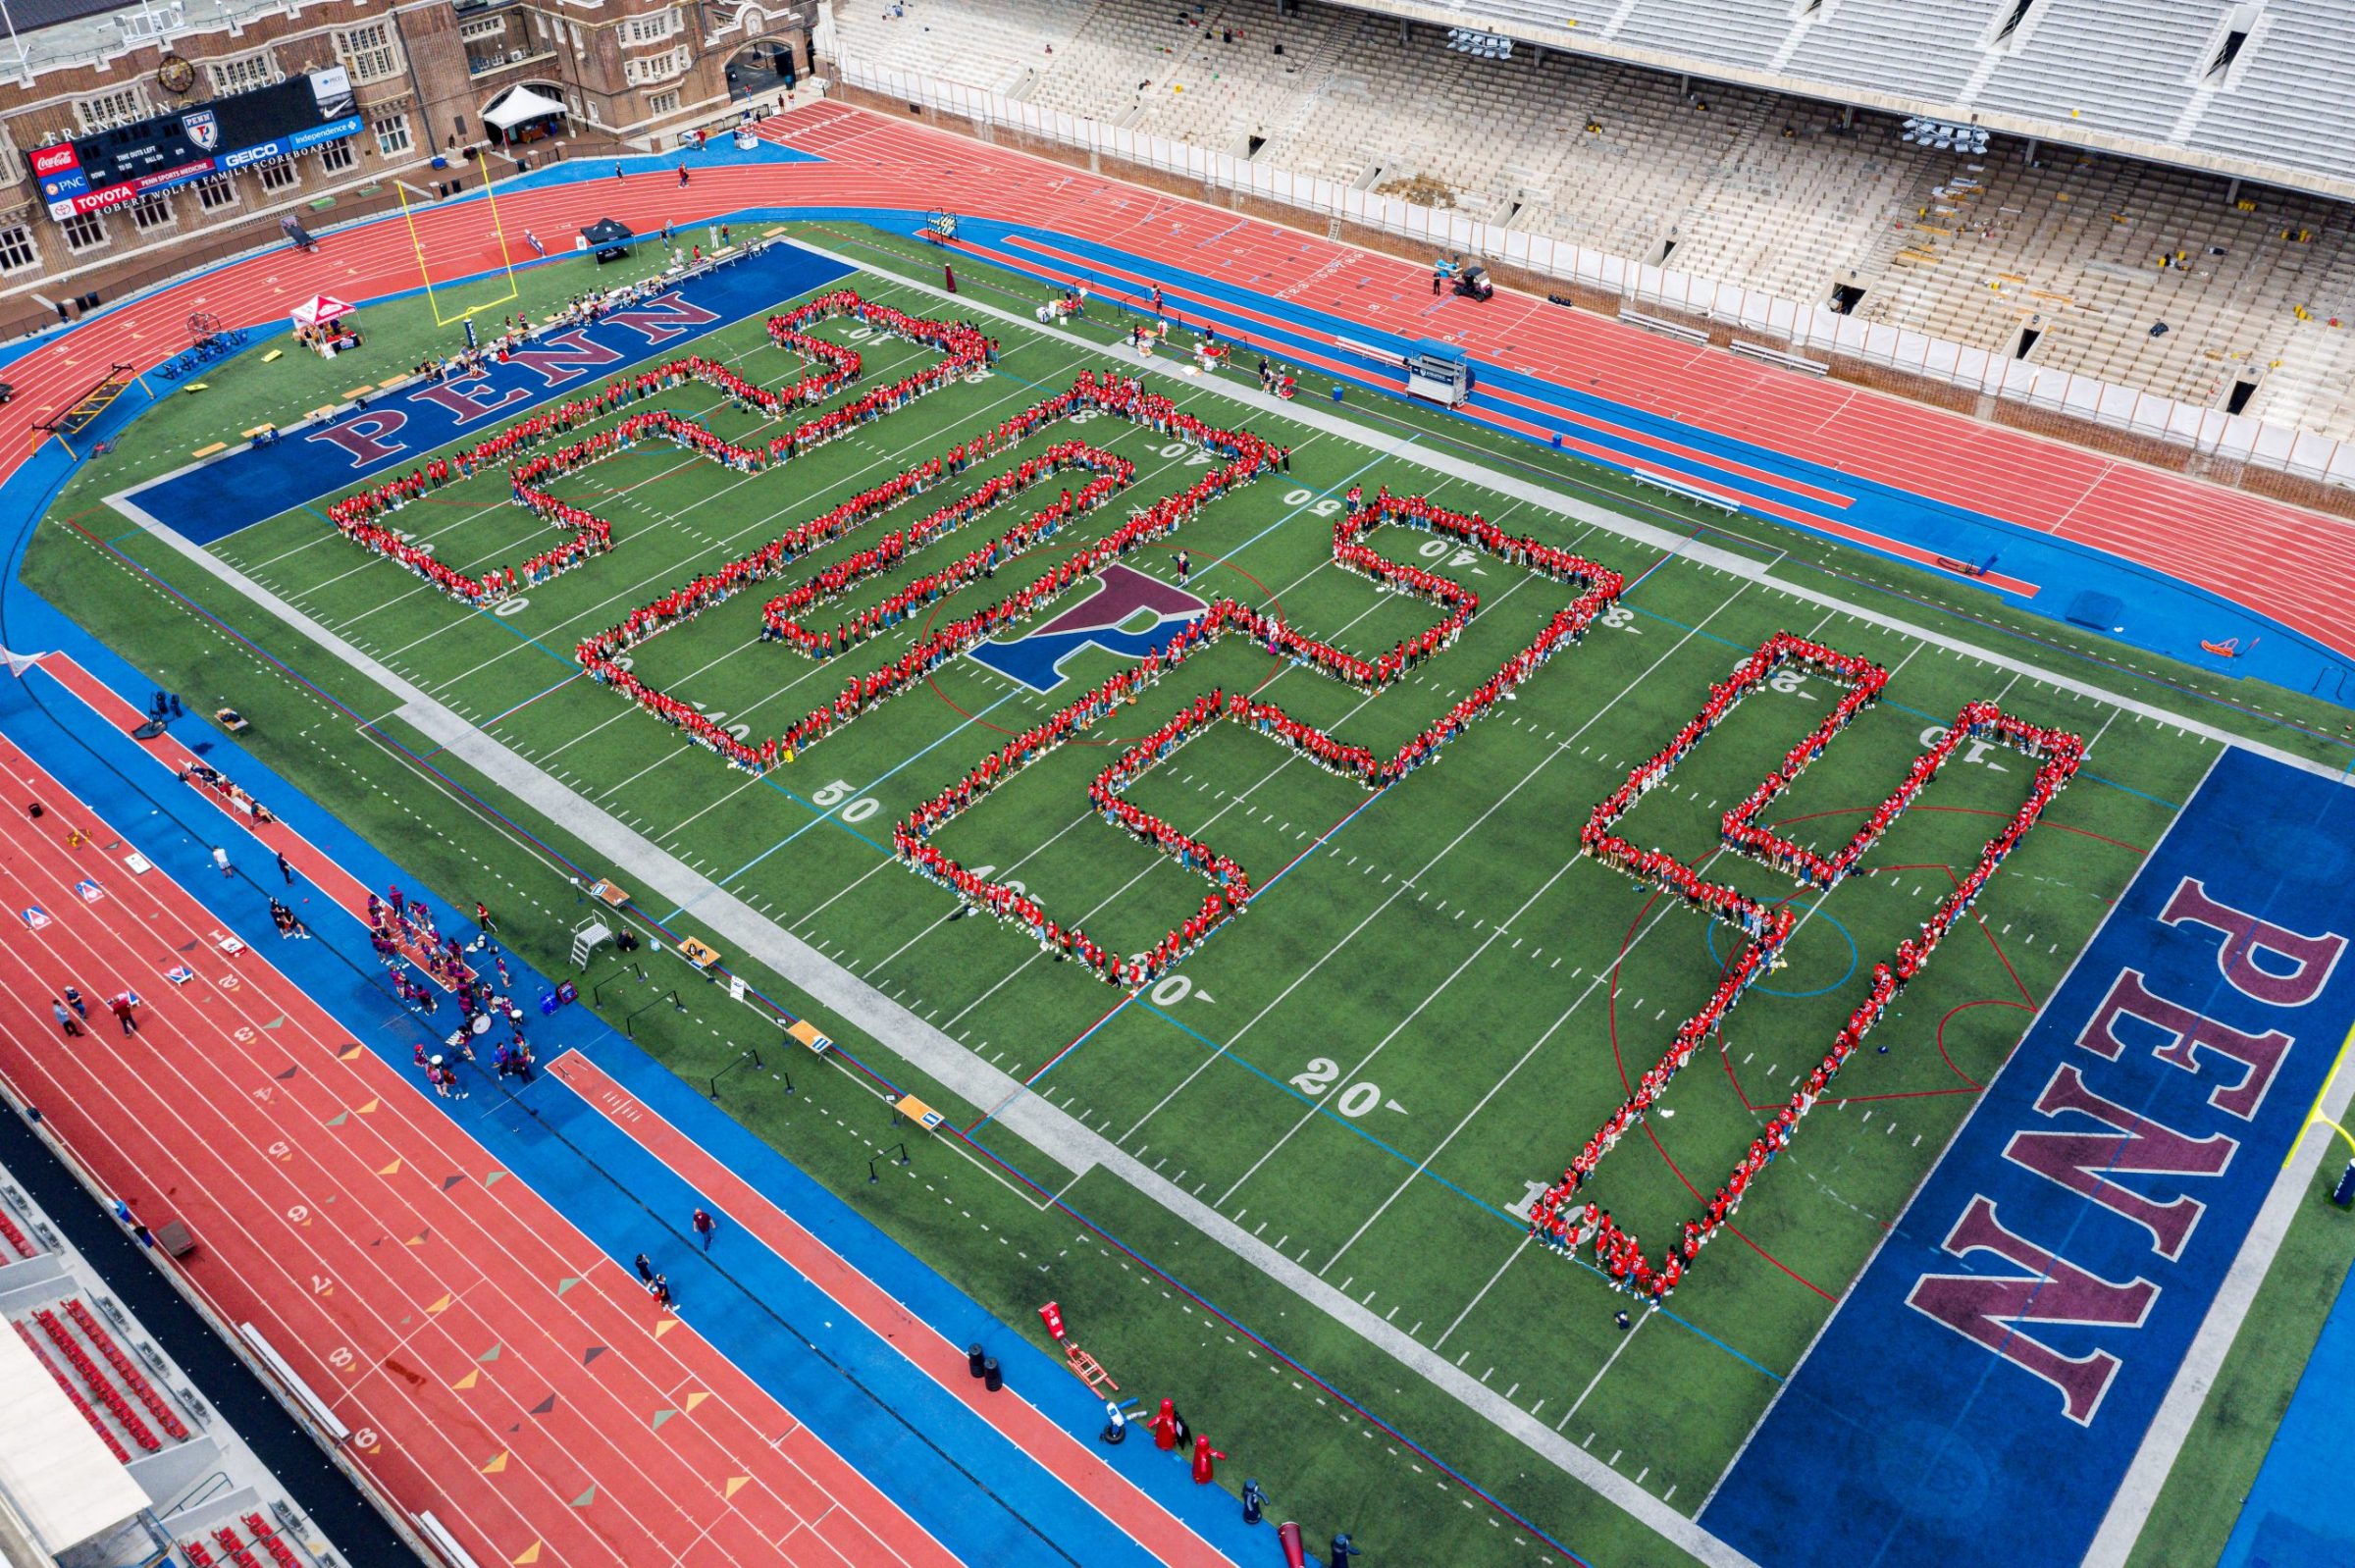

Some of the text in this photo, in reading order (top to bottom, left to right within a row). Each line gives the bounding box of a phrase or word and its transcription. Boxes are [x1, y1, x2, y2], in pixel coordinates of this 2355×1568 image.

[46, 71, 286, 146] FRANKLIN FIELD
[186, 113, 211, 126] PENN
[295, 123, 347, 144] Independence
[130, 149, 144, 158] OUTS
[143, 146, 156, 155] LEFT
[226, 142, 279, 167] GEICO
[59, 177, 85, 191] PNC
[93, 195, 146, 217] ROBERT
[151, 183, 186, 200] WOLF
[203, 163, 249, 185] FAMILY
[252, 140, 335, 171] SCOREBOARD
[140, 178, 158, 186] PENN
[158, 170, 180, 183] SPORTS
[180, 162, 208, 176] MEDICINE
[77, 186, 132, 210] TOYOTA
[306, 290, 721, 468] PENN
[1282, 490, 1341, 517] 50
[1419, 539, 1479, 568] 40
[812, 779, 881, 824] 50
[218, 973, 238, 989] 2
[234, 1026, 255, 1042] 3
[253, 1086, 273, 1101] 4
[1287, 1056, 1382, 1118] 20
[268, 1141, 290, 1156] 5
[1906, 875, 2349, 1428] PENN
[288, 1205, 308, 1223] 6
[311, 1275, 333, 1295] 7
[329, 1346, 353, 1368] 8
[354, 1427, 378, 1449] 9
